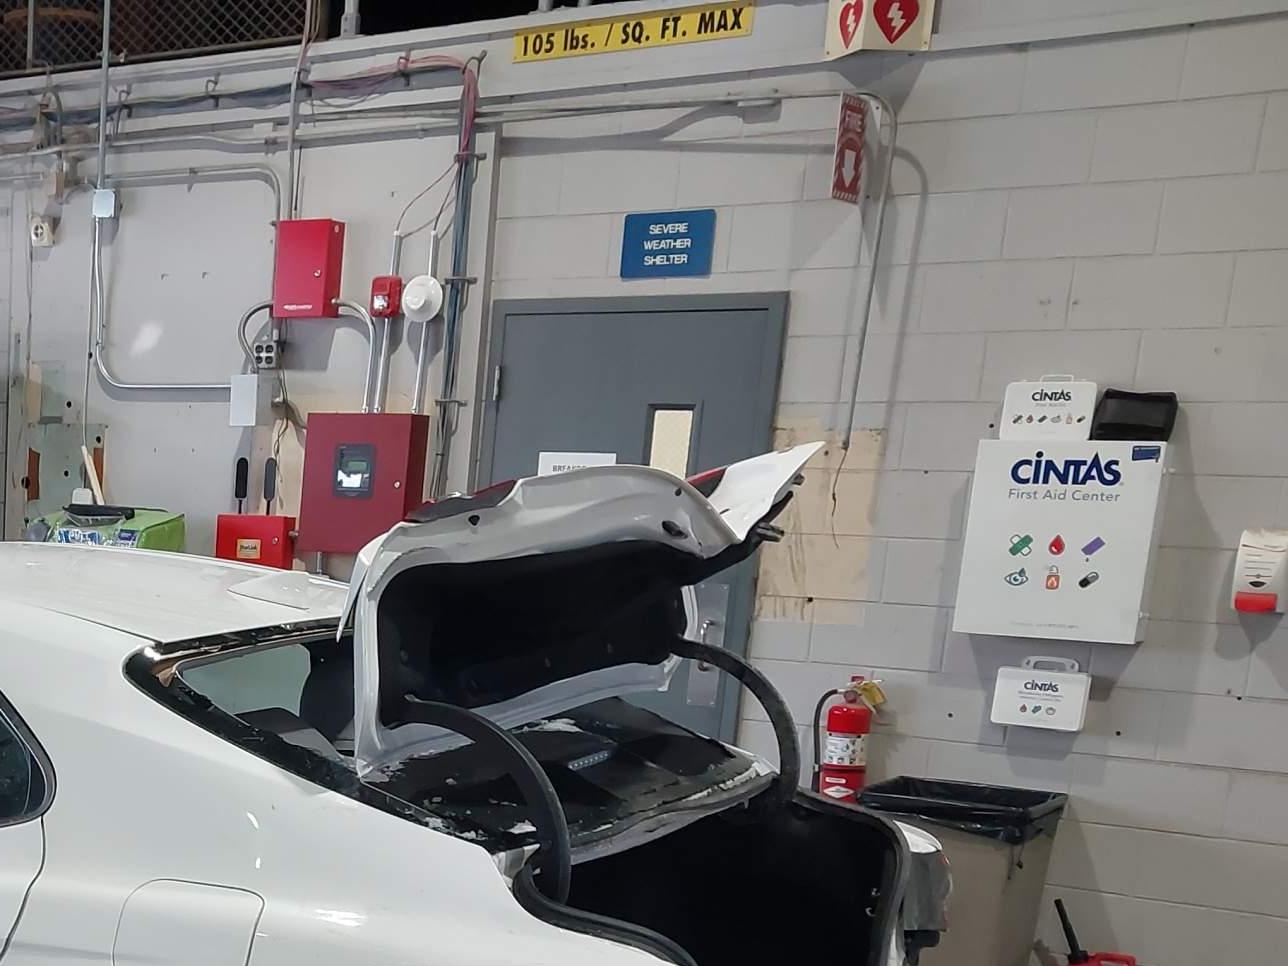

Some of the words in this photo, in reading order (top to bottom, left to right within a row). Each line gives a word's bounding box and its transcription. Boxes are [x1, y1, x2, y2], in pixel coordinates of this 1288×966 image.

[522, 32, 555, 56] 105
[563, 28, 595, 52] lbs.
[604, 23, 614, 46] /
[620, 20, 651, 45] SQ.
[660, 15, 687, 40] FT.
[697, 7, 745, 35] MAX
[648, 222, 689, 235] SEVERE
[643, 238, 692, 250] WEATHER
[643, 254, 689, 266] SHELTER
[1008, 488, 1038, 501] First
[1042, 489, 1068, 501] Aid
[1072, 489, 1121, 502] Center
